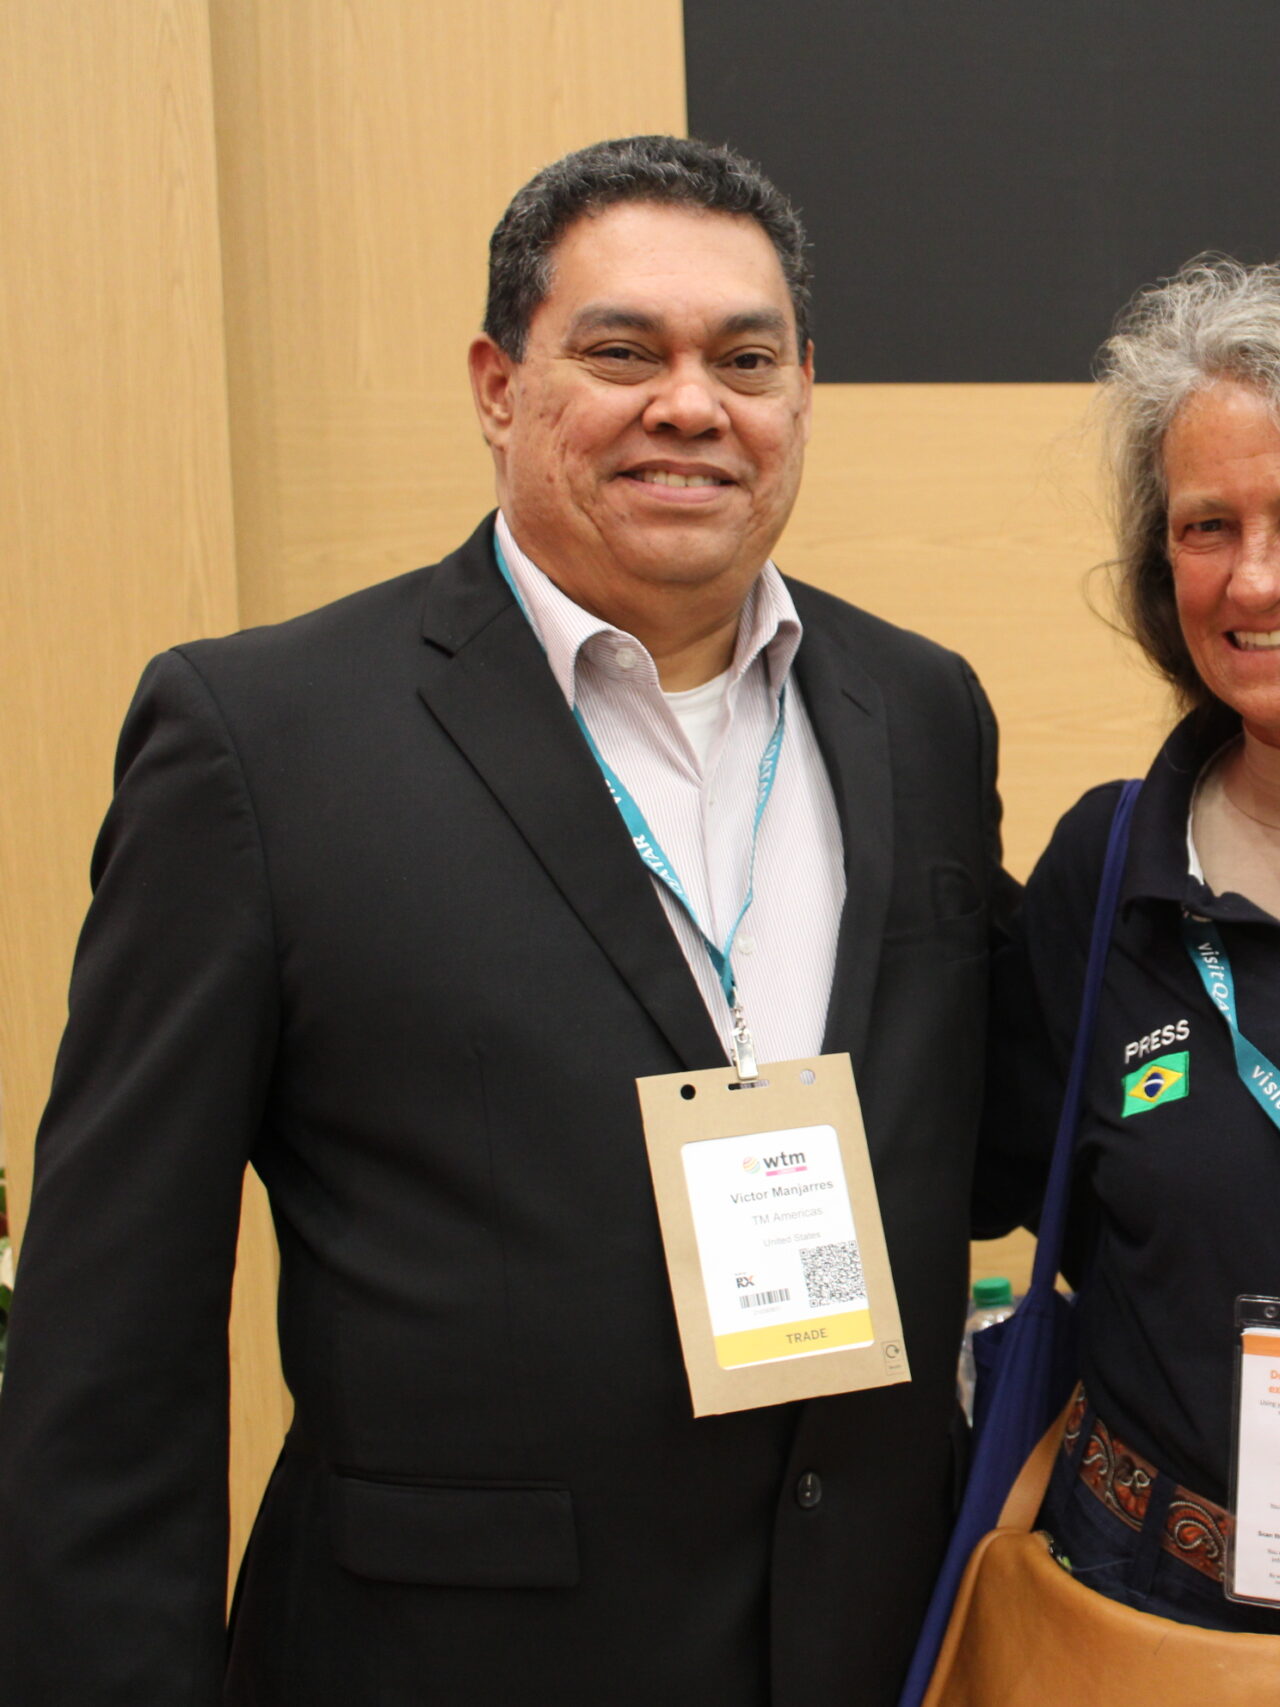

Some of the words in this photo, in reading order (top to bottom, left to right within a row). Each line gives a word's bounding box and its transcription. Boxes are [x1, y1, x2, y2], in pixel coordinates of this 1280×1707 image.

[1124, 1019, 1191, 1064] PRESS
[763, 1151, 806, 1169] wtm
[730, 1191, 769, 1204] Victor
[771, 1180, 834, 1196] Manjarres
[752, 1214, 770, 1226] TM
[773, 1207, 824, 1222] Americas
[786, 1328, 828, 1344] TRADE
